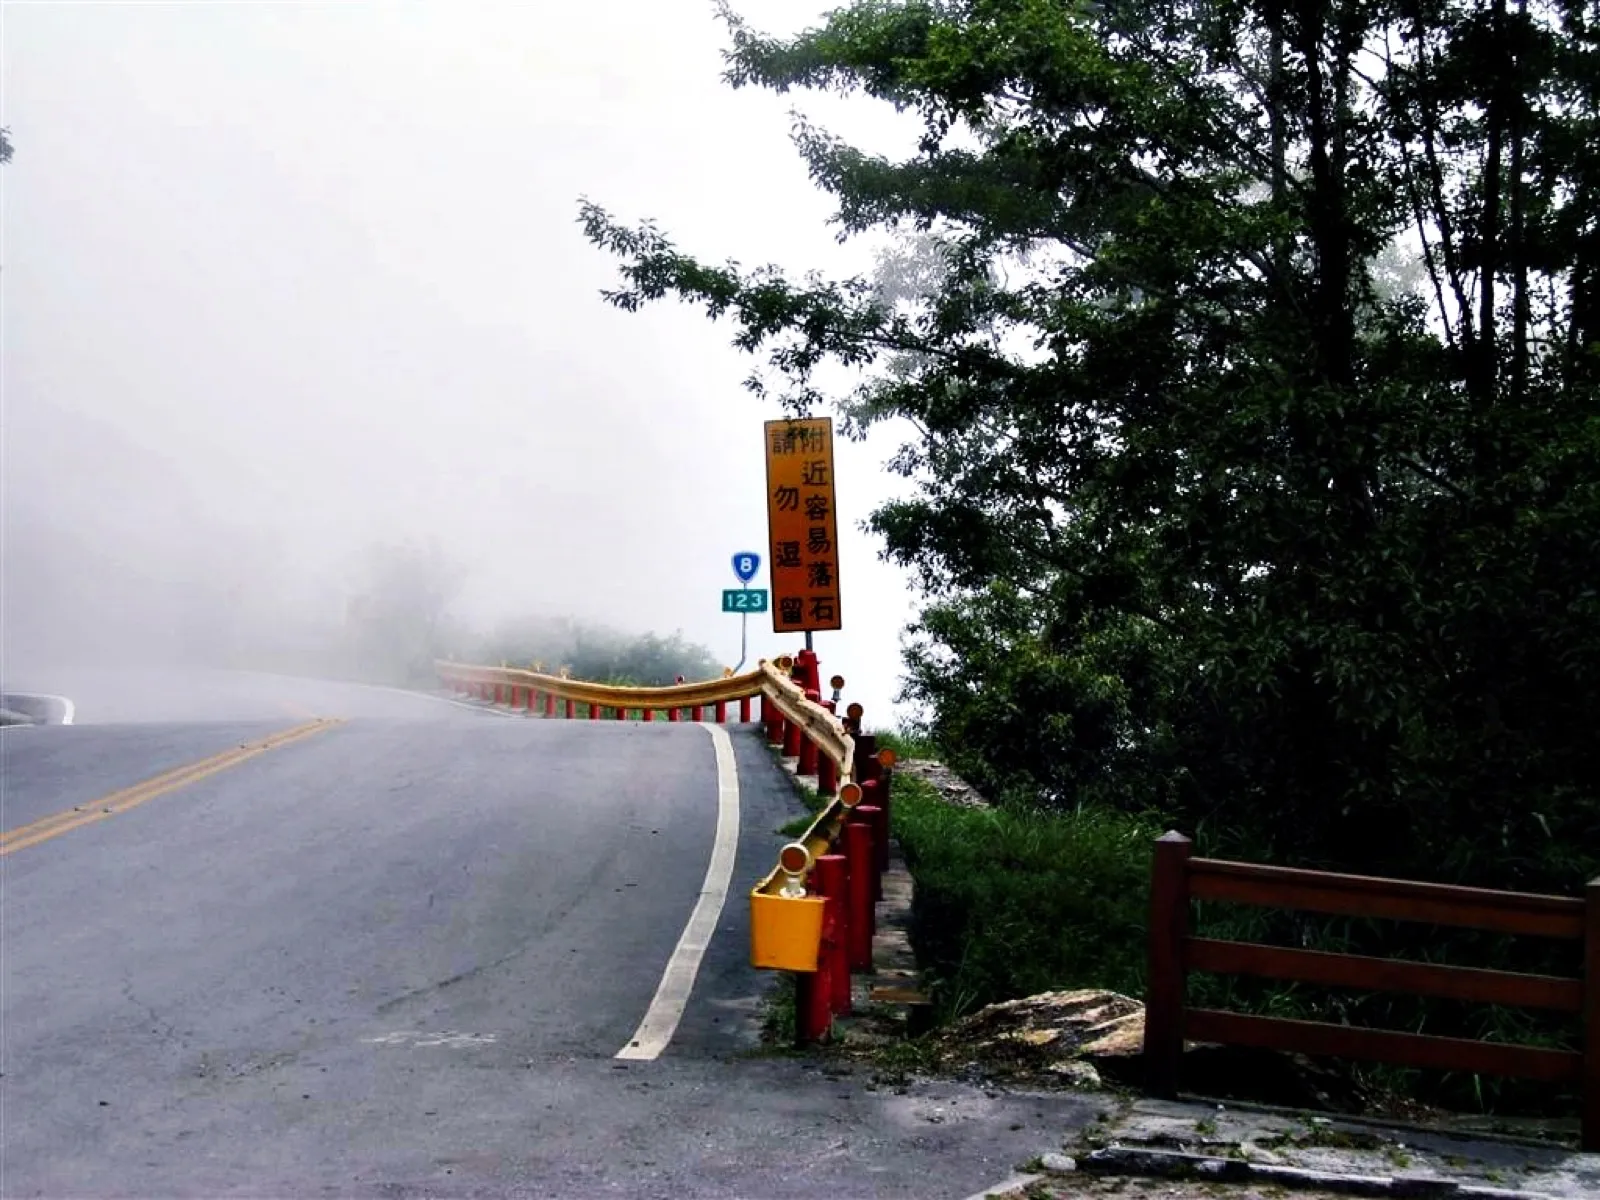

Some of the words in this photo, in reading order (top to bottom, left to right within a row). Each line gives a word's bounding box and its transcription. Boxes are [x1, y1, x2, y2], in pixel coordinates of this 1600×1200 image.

[740, 557, 753, 573] 8
[769, 427, 802, 624] 請勿逗留
[800, 425, 834, 622] 附近容易落石
[727, 593, 762, 608] 123
